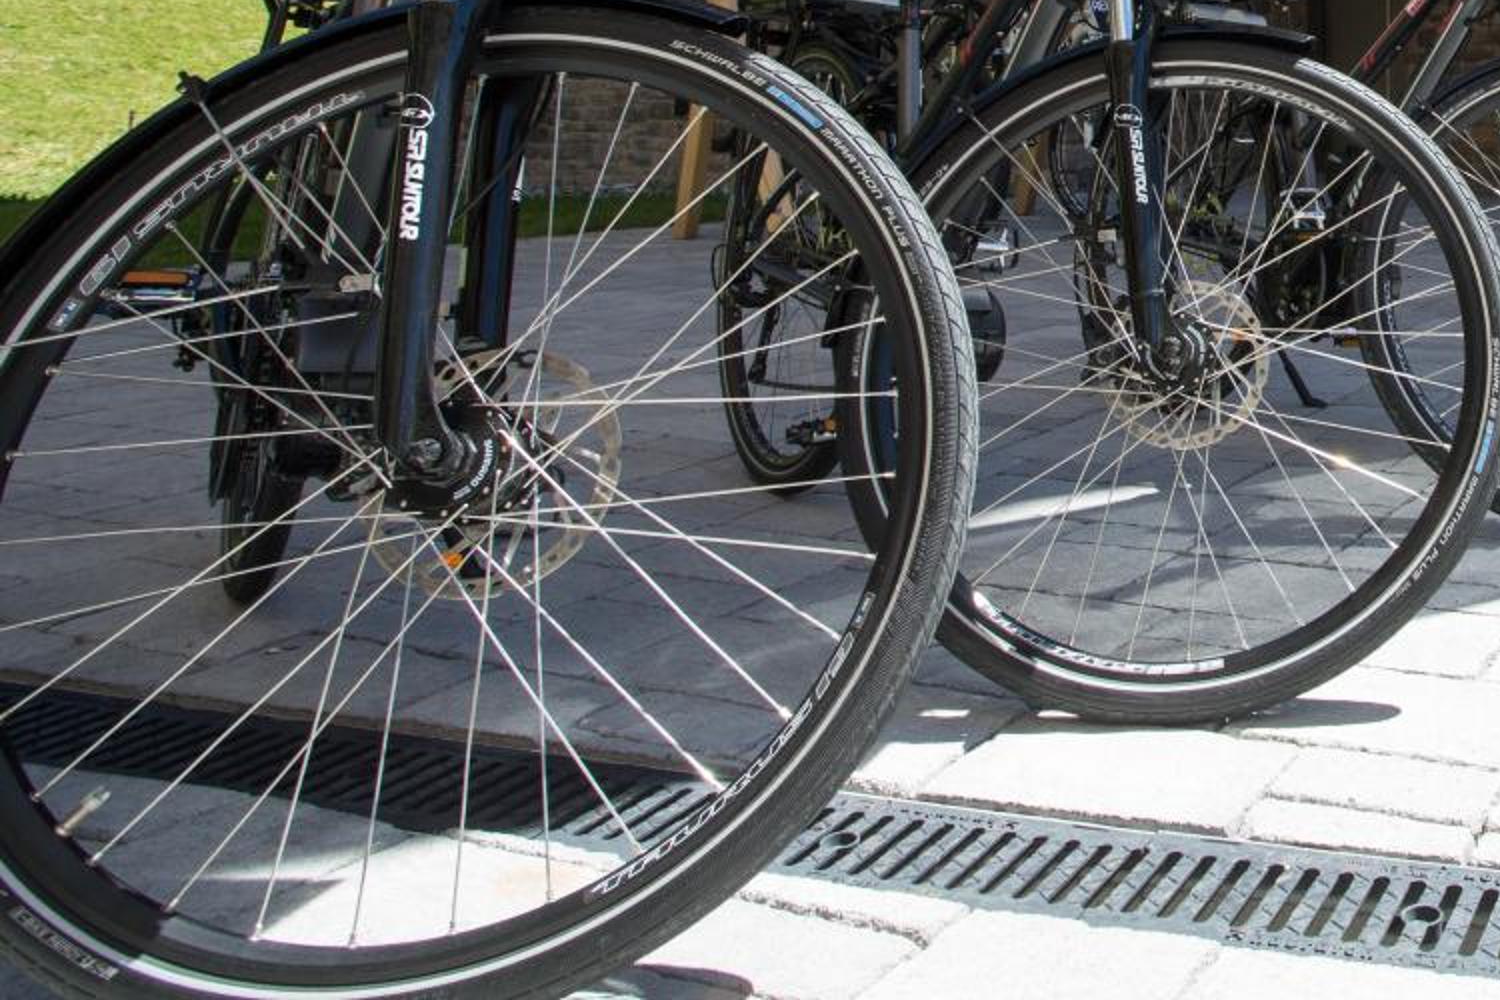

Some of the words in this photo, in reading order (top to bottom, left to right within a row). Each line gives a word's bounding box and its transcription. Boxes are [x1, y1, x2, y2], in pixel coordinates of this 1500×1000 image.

[404, 129, 428, 160] SR
[398, 161, 425, 241] SUNTOUR
[881, 205, 910, 247] PLUS
